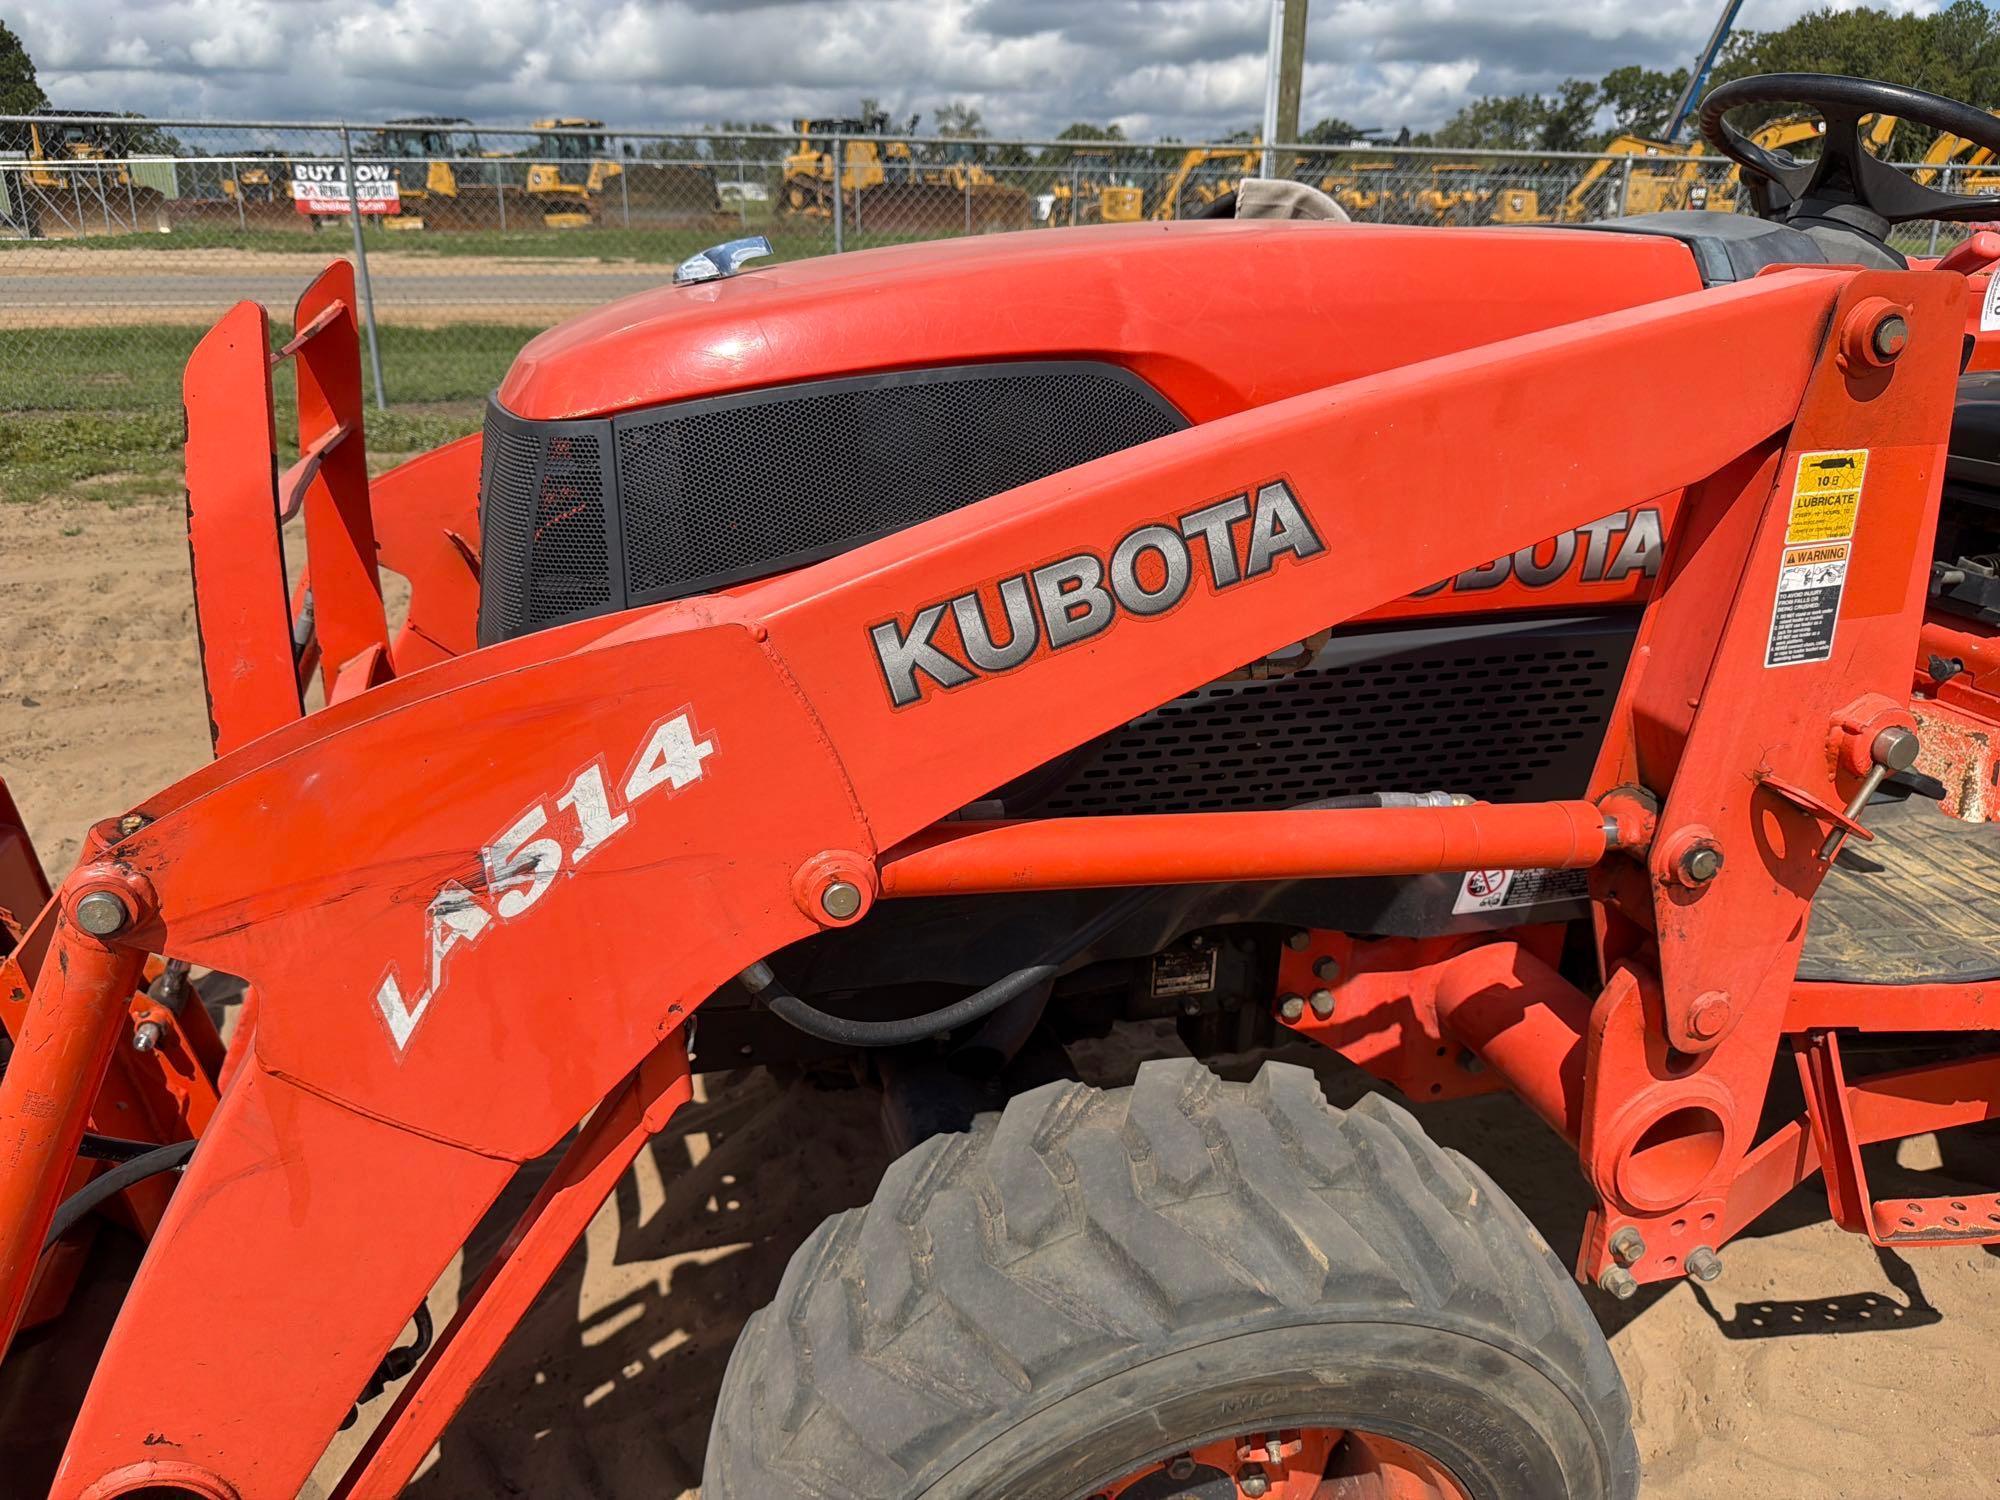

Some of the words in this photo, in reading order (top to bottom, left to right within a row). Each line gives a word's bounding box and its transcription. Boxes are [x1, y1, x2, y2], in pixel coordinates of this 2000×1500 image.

[295, 165, 335, 181] BUY
[1817, 476, 1830, 487] 10
[1797, 494, 1855, 508] LUBRICATE
[1797, 547, 1844, 562] WARNING
[870, 479, 1326, 708] KUBOTA
[377, 713, 714, 1051] LA514
[1220, 1386, 1289, 1414] NYLON
